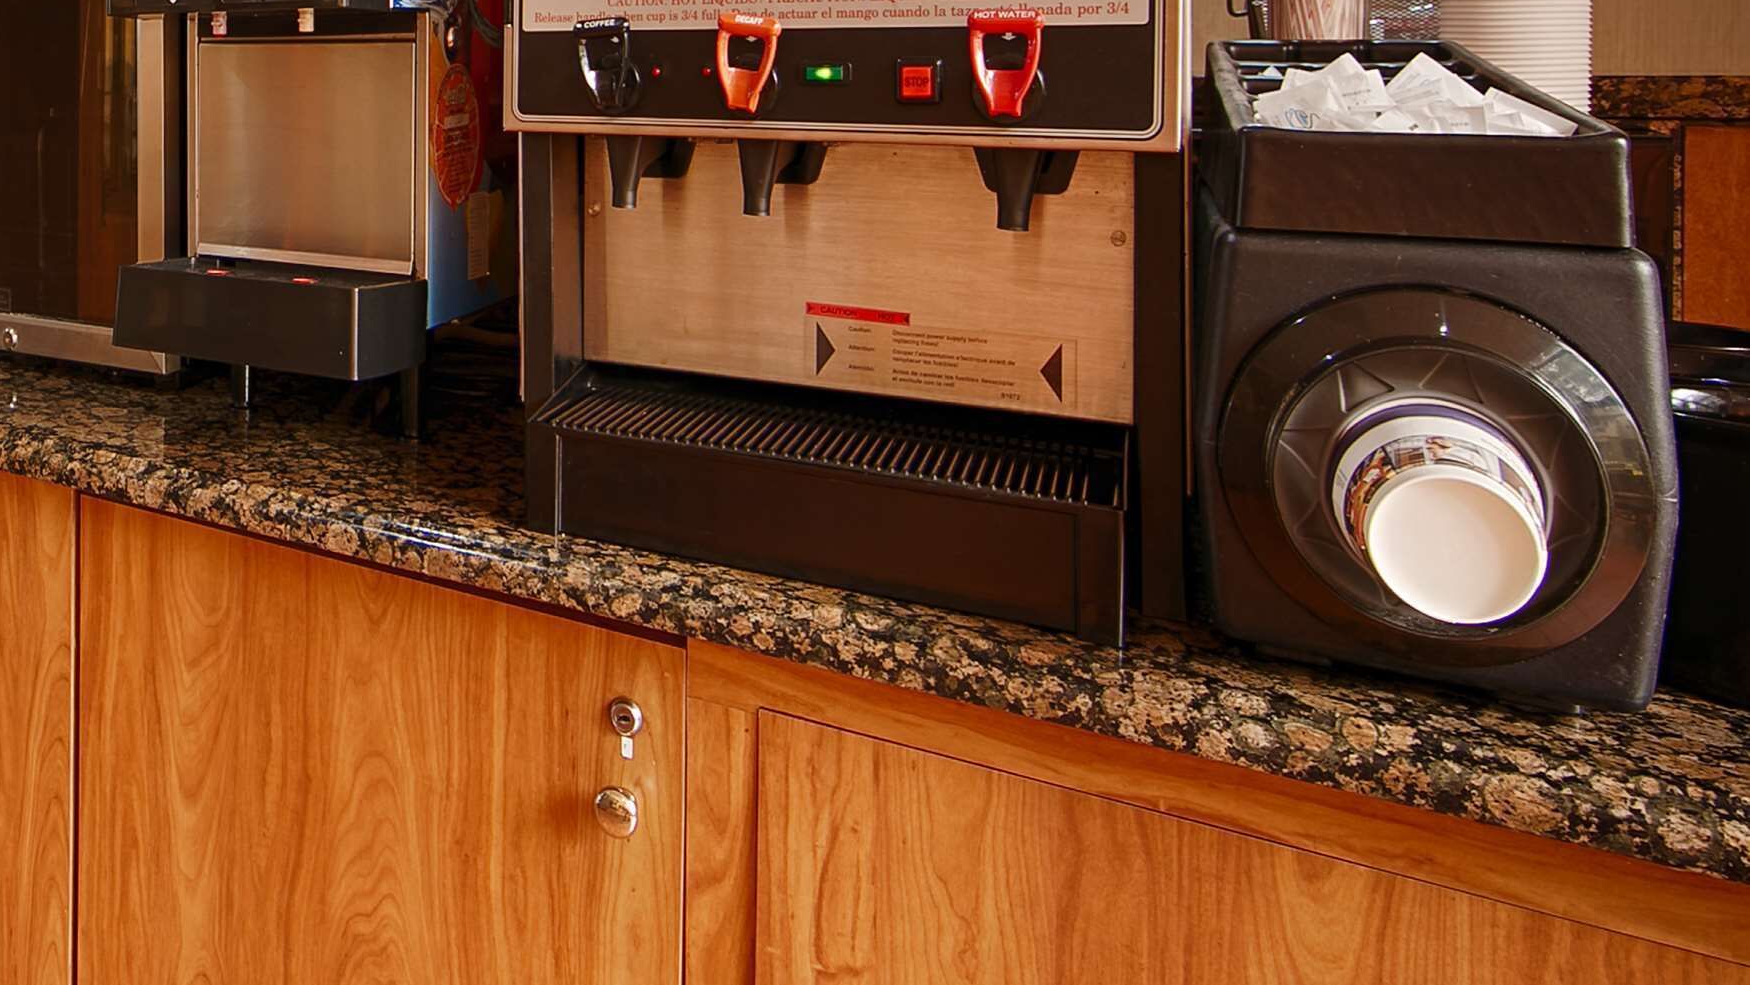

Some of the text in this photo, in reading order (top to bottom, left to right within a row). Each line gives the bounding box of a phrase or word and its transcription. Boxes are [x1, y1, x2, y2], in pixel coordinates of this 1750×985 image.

[535, 12, 573, 23] Release
[646, 13, 666, 24] cup
[669, 10, 679, 21] is
[681, 10, 698, 21] 3/4
[778, 9, 818, 19] actuar
[821, 7, 831, 18] el
[836, 9, 879, 21] mango
[883, 5, 930, 18] cuando
[934, 5, 946, 16] la
[951, 6, 976, 17] taz
[1077, 5, 1102, 18] por
[1107, 2, 1129, 14] 3/4
[974, 10, 1036, 19] HOT WATER
[584, 19, 615, 29] COFFEE
[905, 76, 929, 87] STOP
